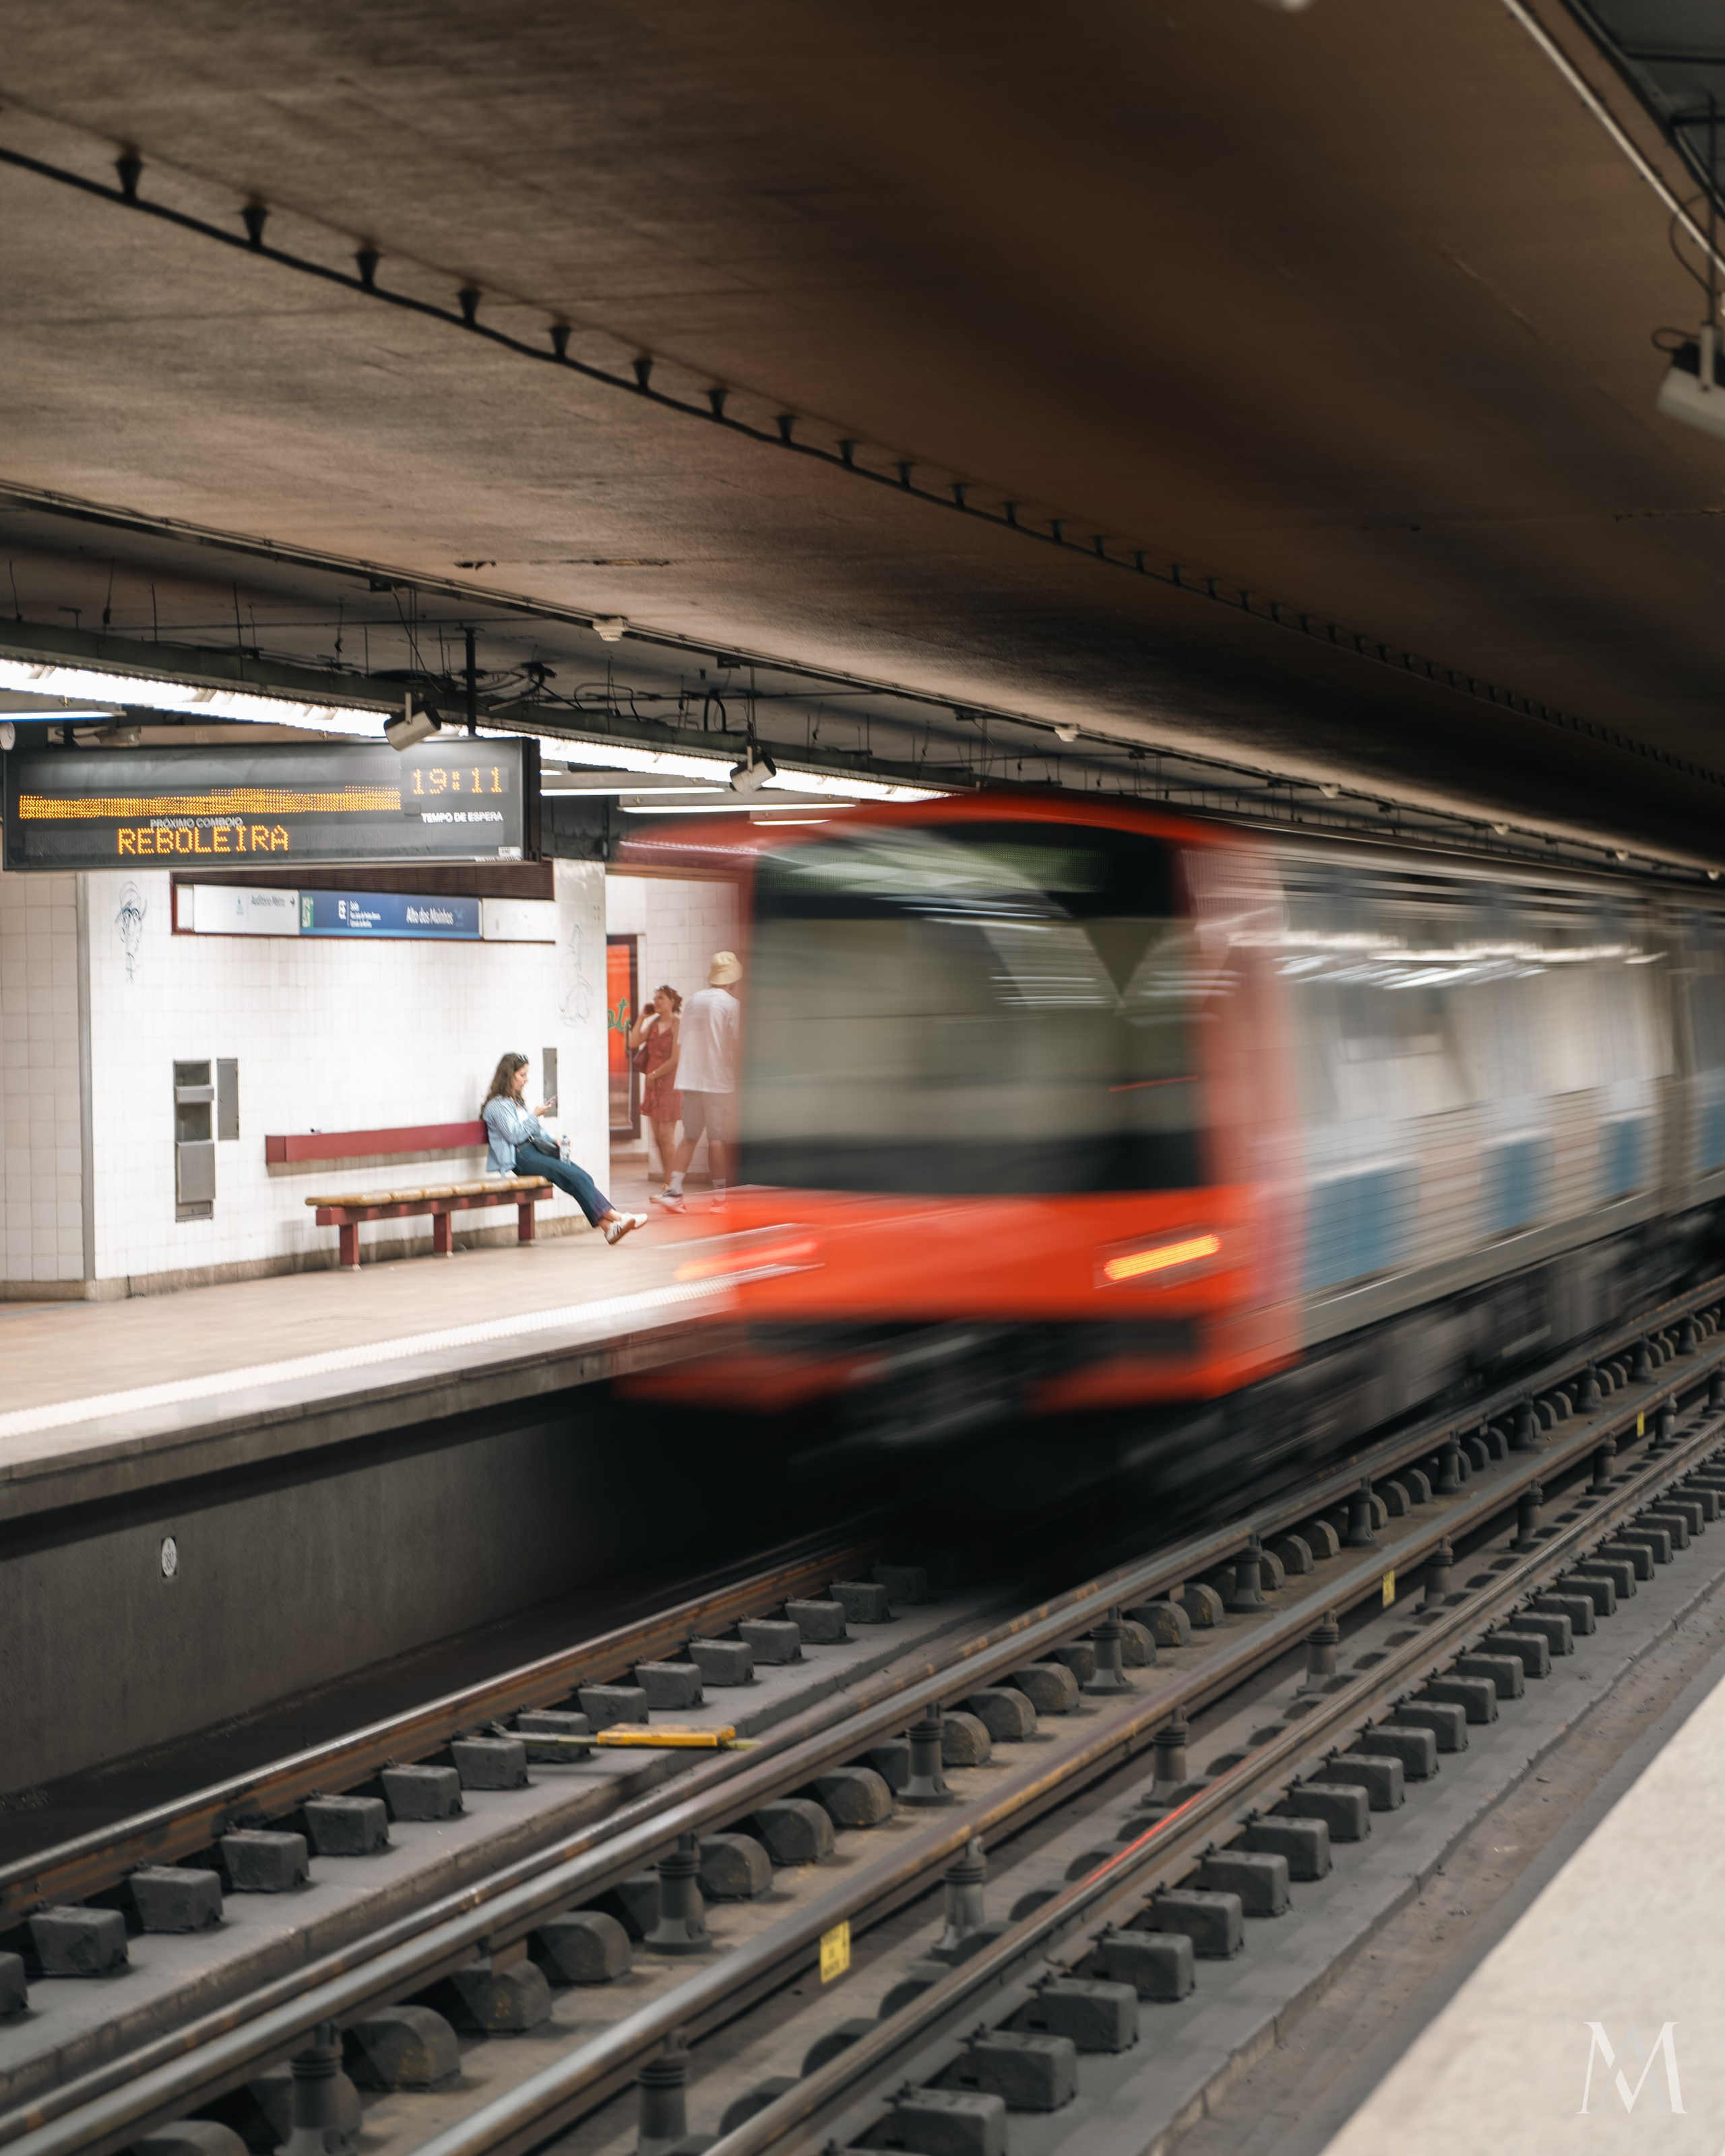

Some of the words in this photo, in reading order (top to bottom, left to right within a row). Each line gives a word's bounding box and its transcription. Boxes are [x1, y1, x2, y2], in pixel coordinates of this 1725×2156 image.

[413, 767, 503, 794] 19:11
[196, 817, 243, 828] COMBOIO
[421, 812, 453, 823] TEMPO
[453, 812, 467, 823] DE
[468, 811, 504, 822] ESPERA
[117, 824, 289, 855] REBOLEIRA
[406, 906, 419, 924] Alto
[418, 906, 430, 924] dos
